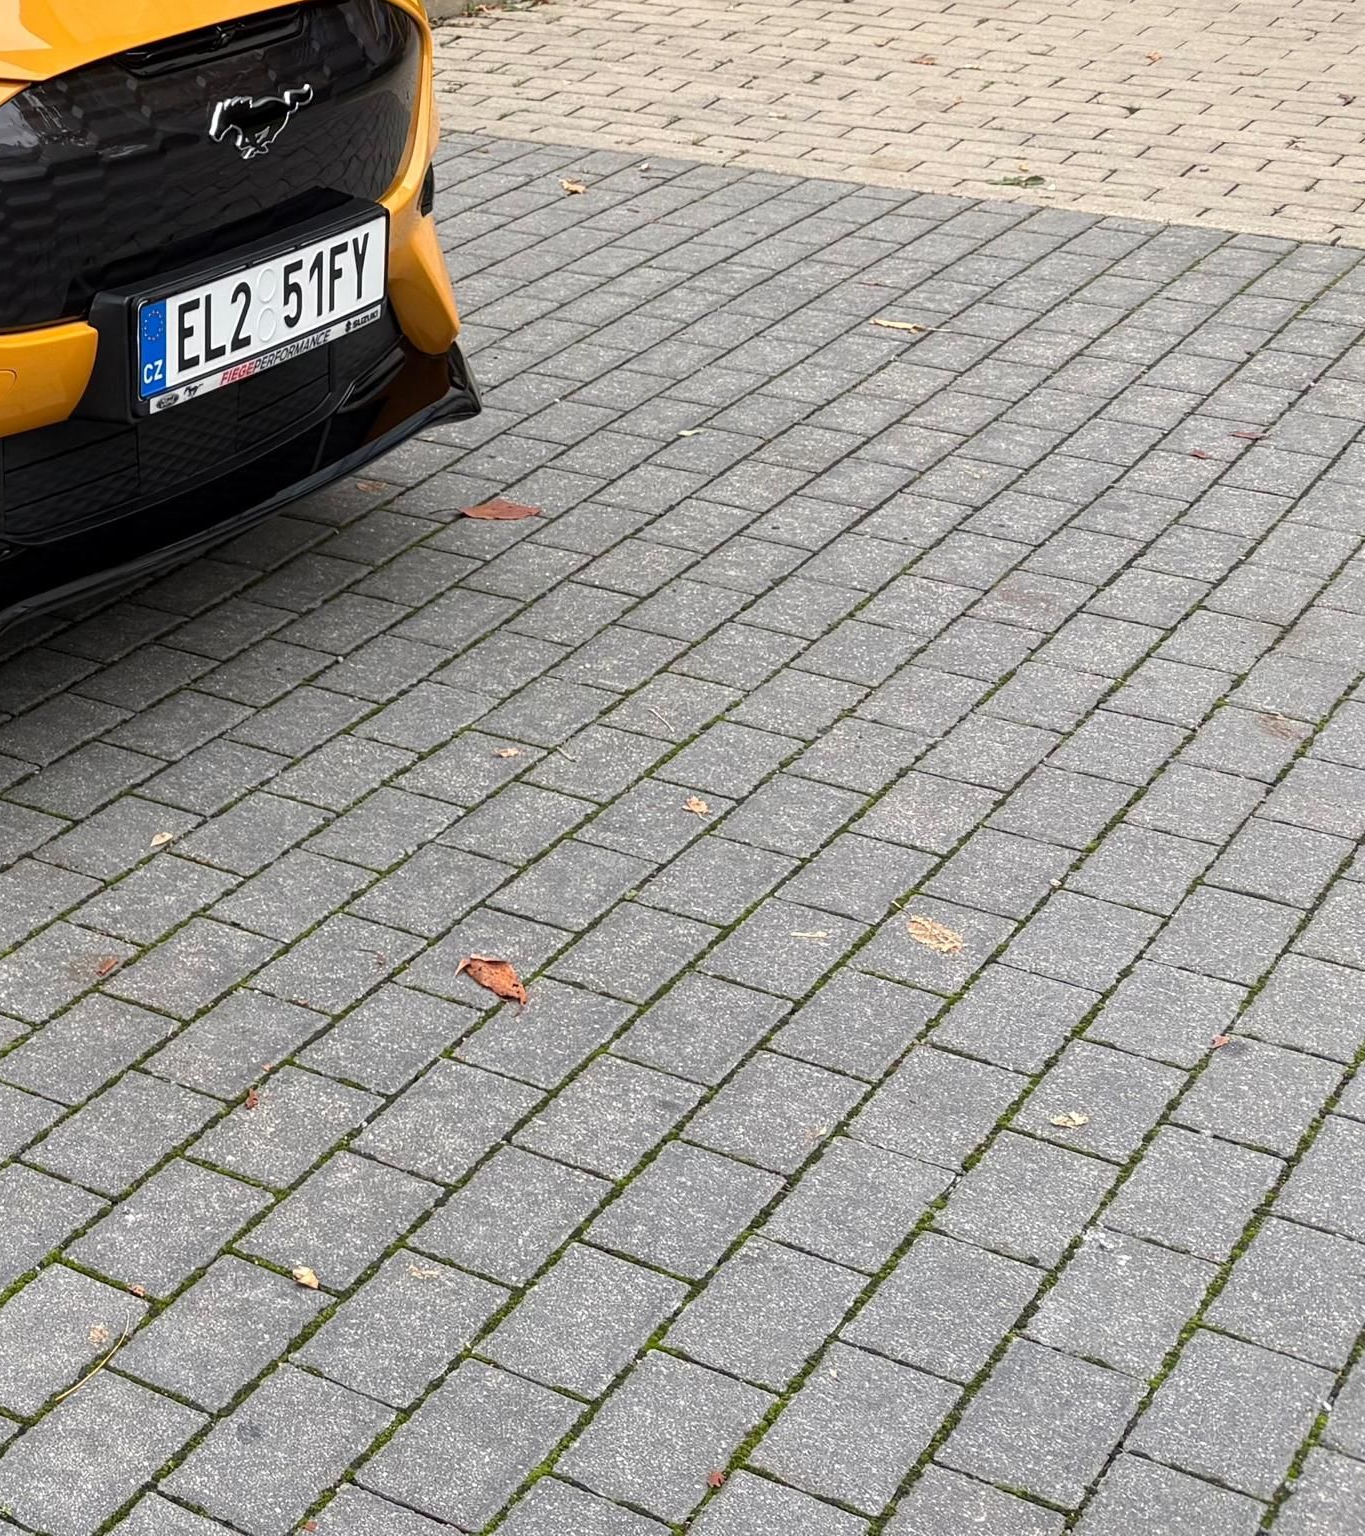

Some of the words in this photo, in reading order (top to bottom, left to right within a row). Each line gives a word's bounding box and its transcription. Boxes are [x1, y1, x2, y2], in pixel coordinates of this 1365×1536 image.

[177, 281, 252, 373] EL2
[282, 232, 370, 329] 51FY
[142, 359, 164, 385] CZ
